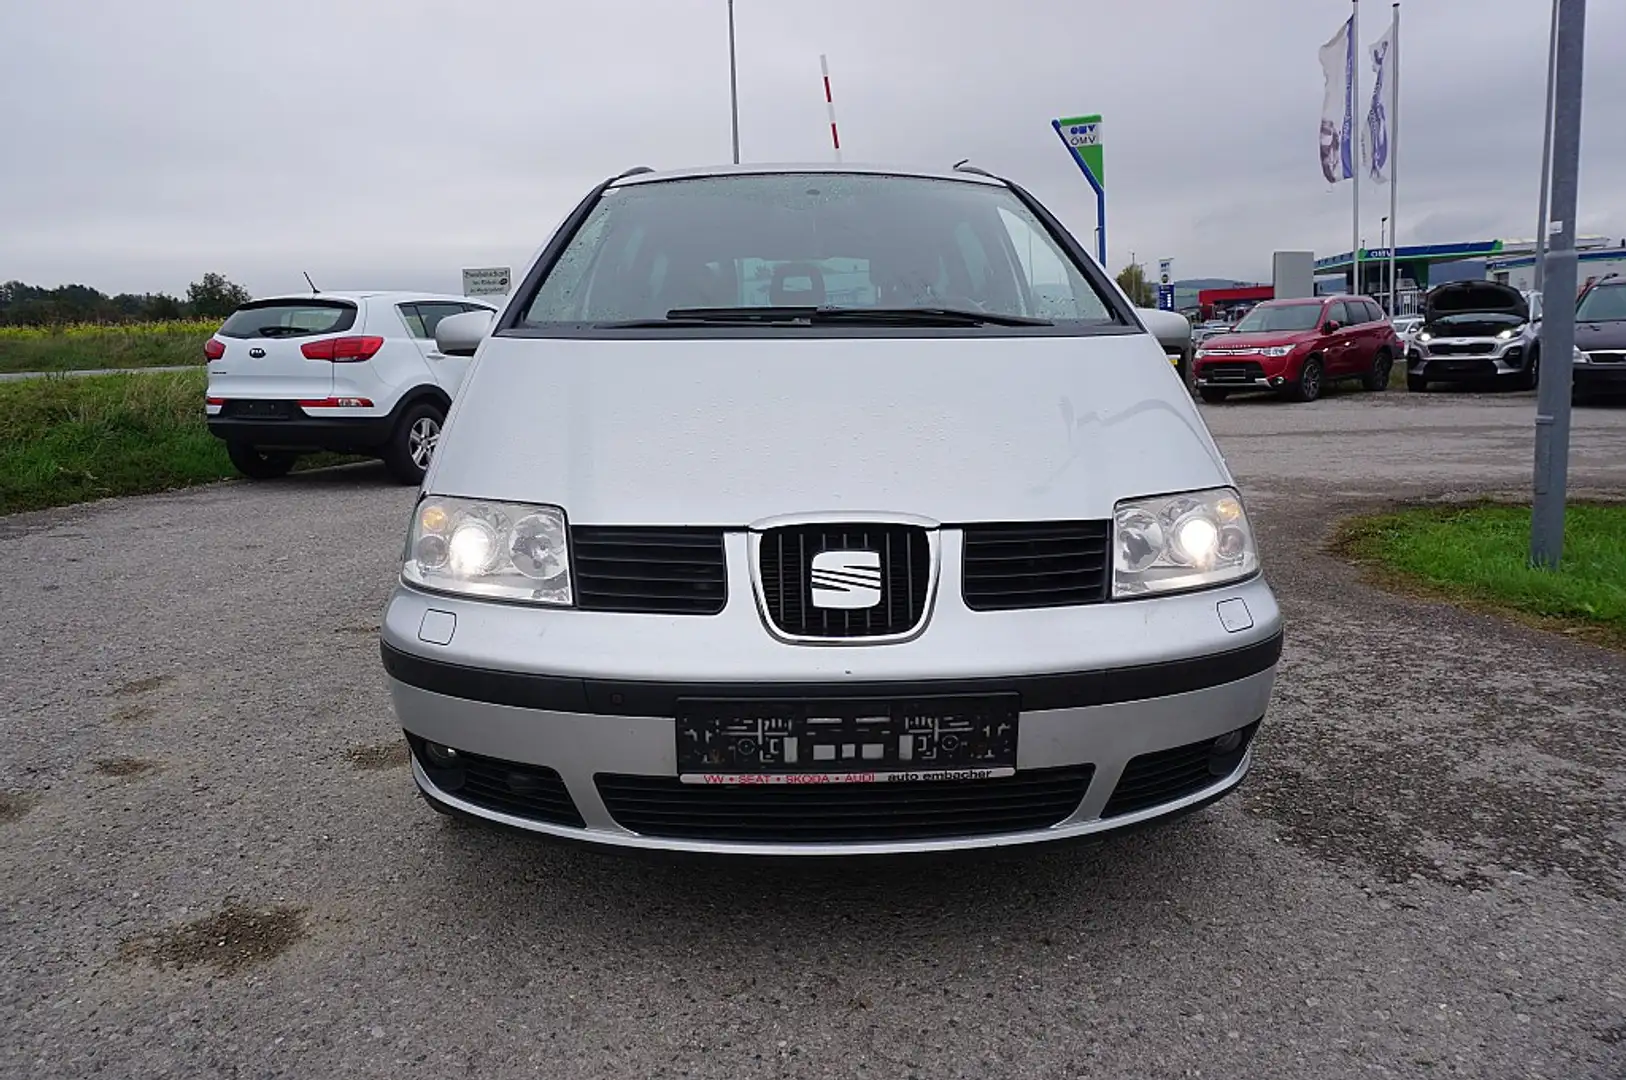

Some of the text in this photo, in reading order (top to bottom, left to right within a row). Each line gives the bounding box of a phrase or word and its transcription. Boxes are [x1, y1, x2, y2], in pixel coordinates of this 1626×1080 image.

[1070, 136, 1096, 145] OMV
[703, 774, 724, 784] VW
[738, 774, 771, 784] SEAT
[844, 773, 875, 783] AUDI
[887, 772, 919, 782] auto
[922, 769, 992, 781] embacher
